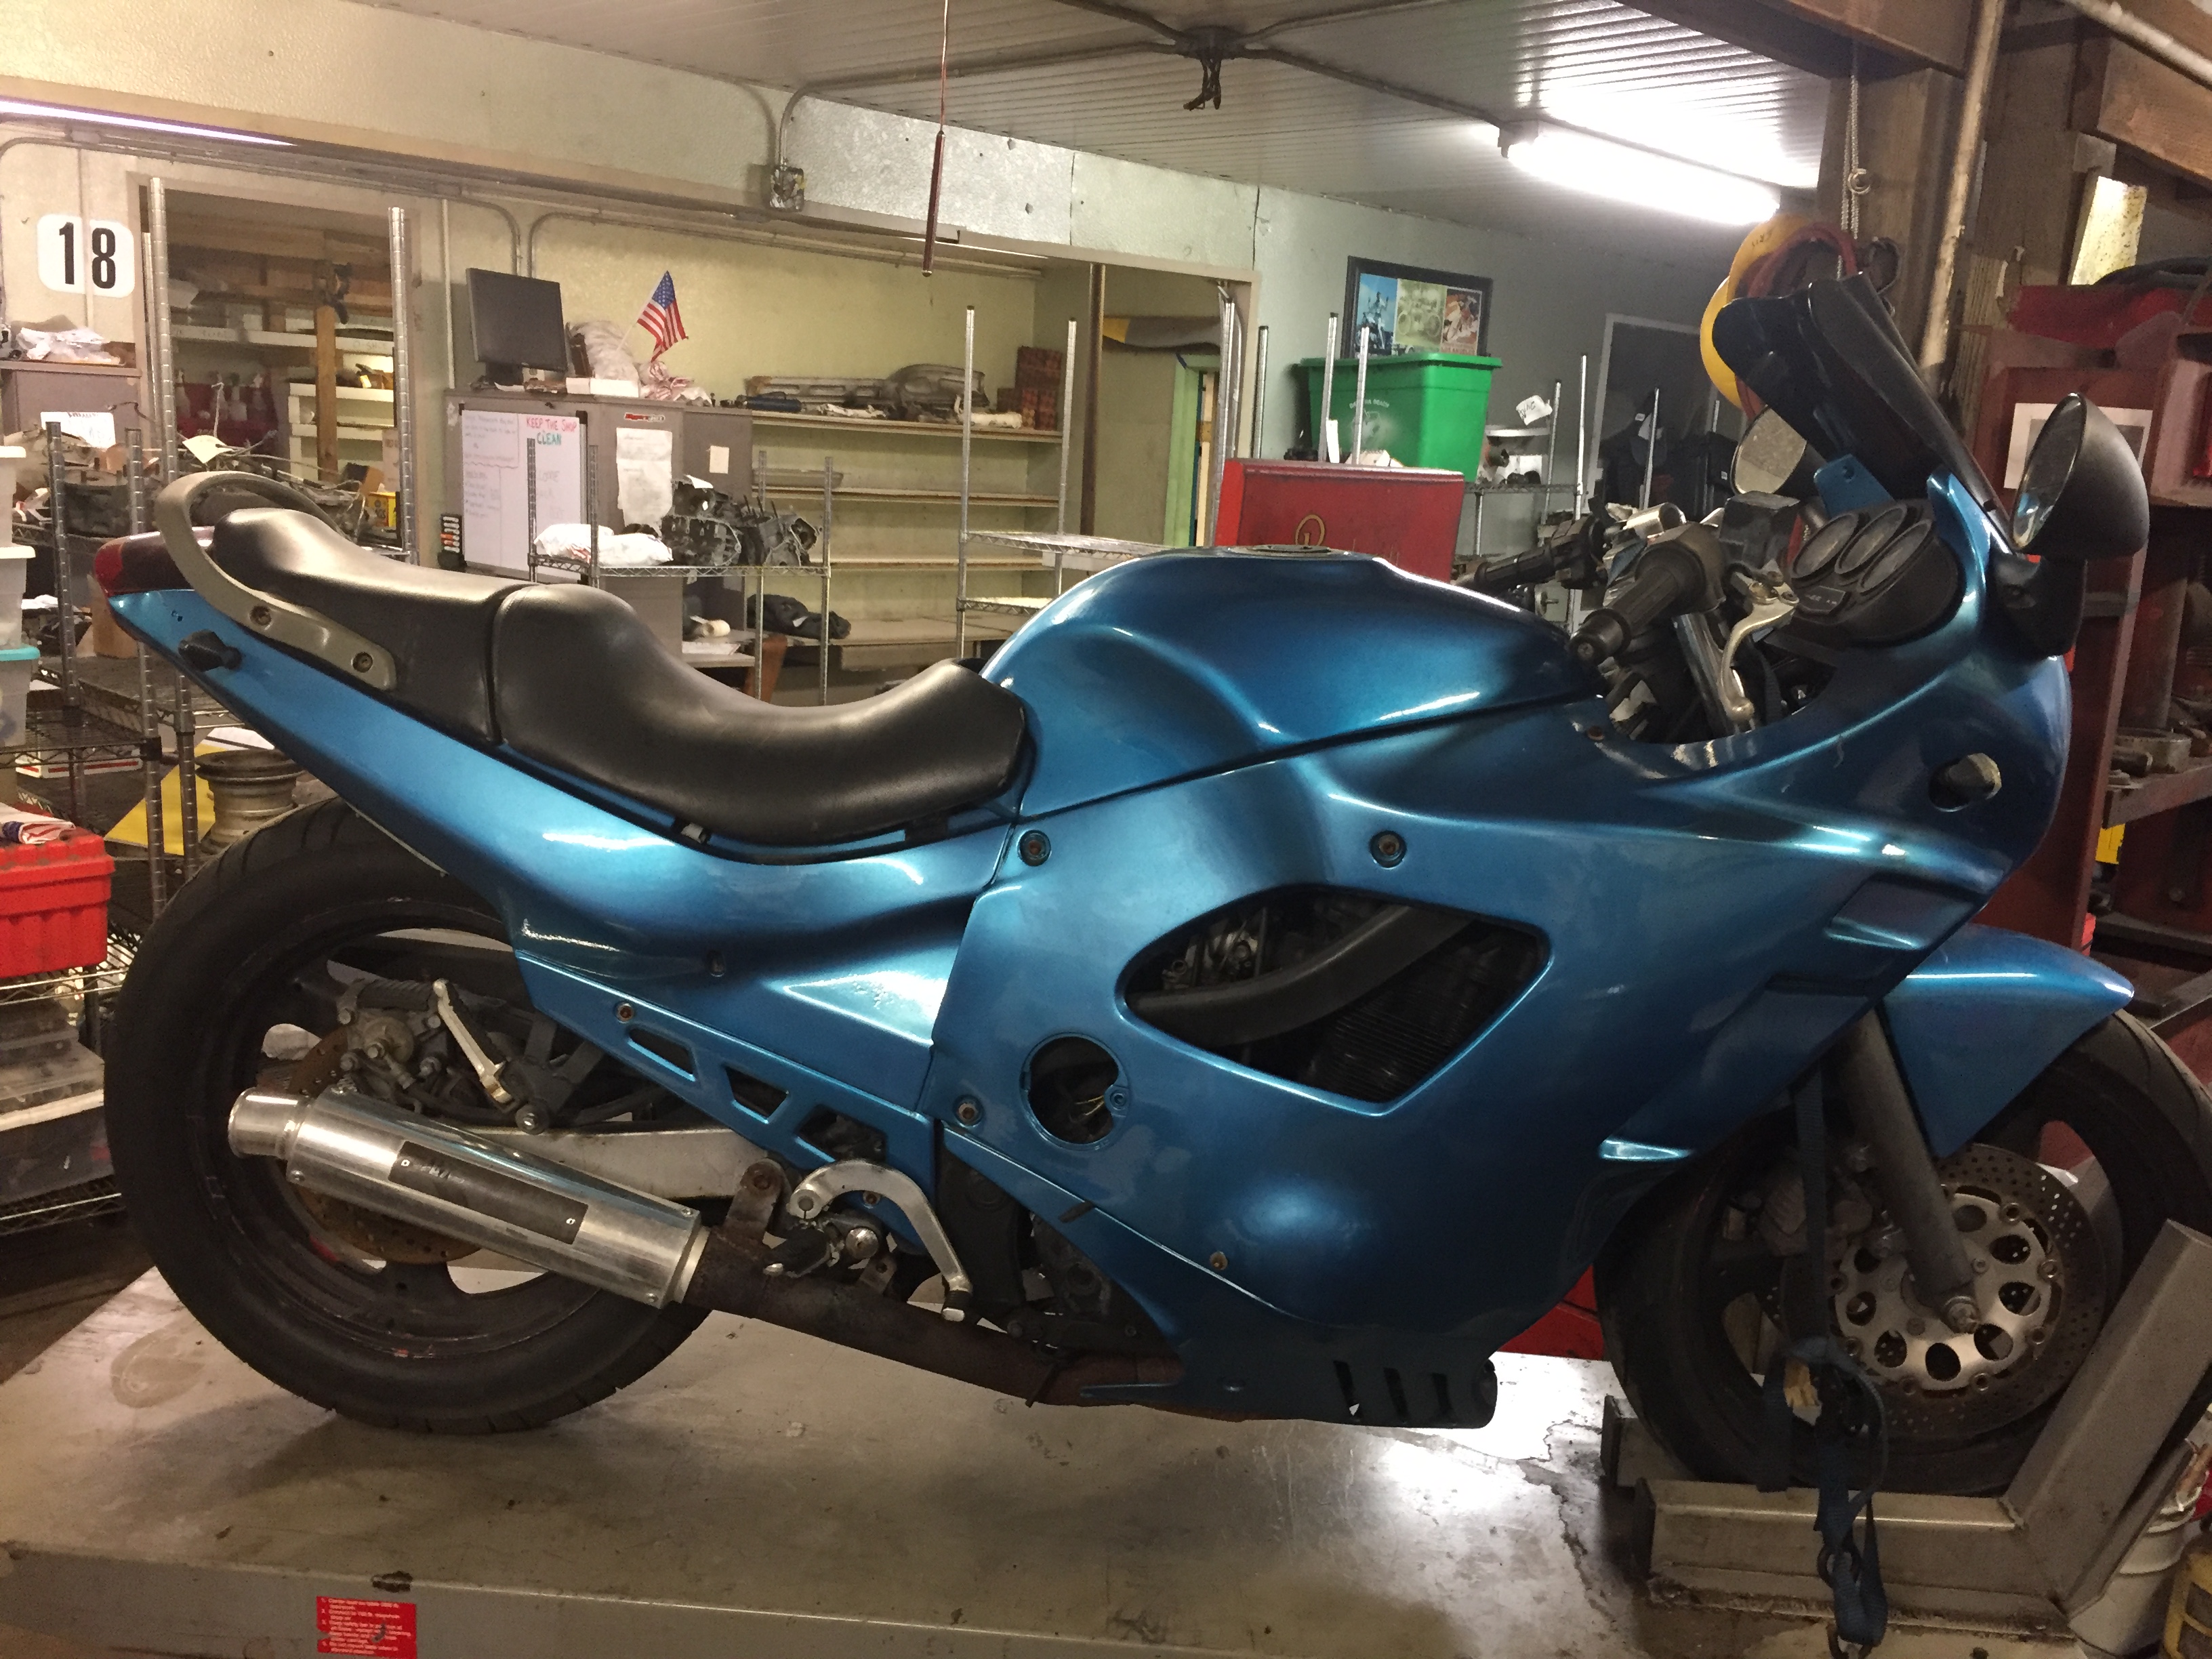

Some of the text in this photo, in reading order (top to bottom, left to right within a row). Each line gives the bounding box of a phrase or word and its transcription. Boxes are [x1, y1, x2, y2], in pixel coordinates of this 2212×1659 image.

[59, 222, 116, 289] 18
[527, 417, 542, 428] KEEP
[545, 419, 558, 430] THE
